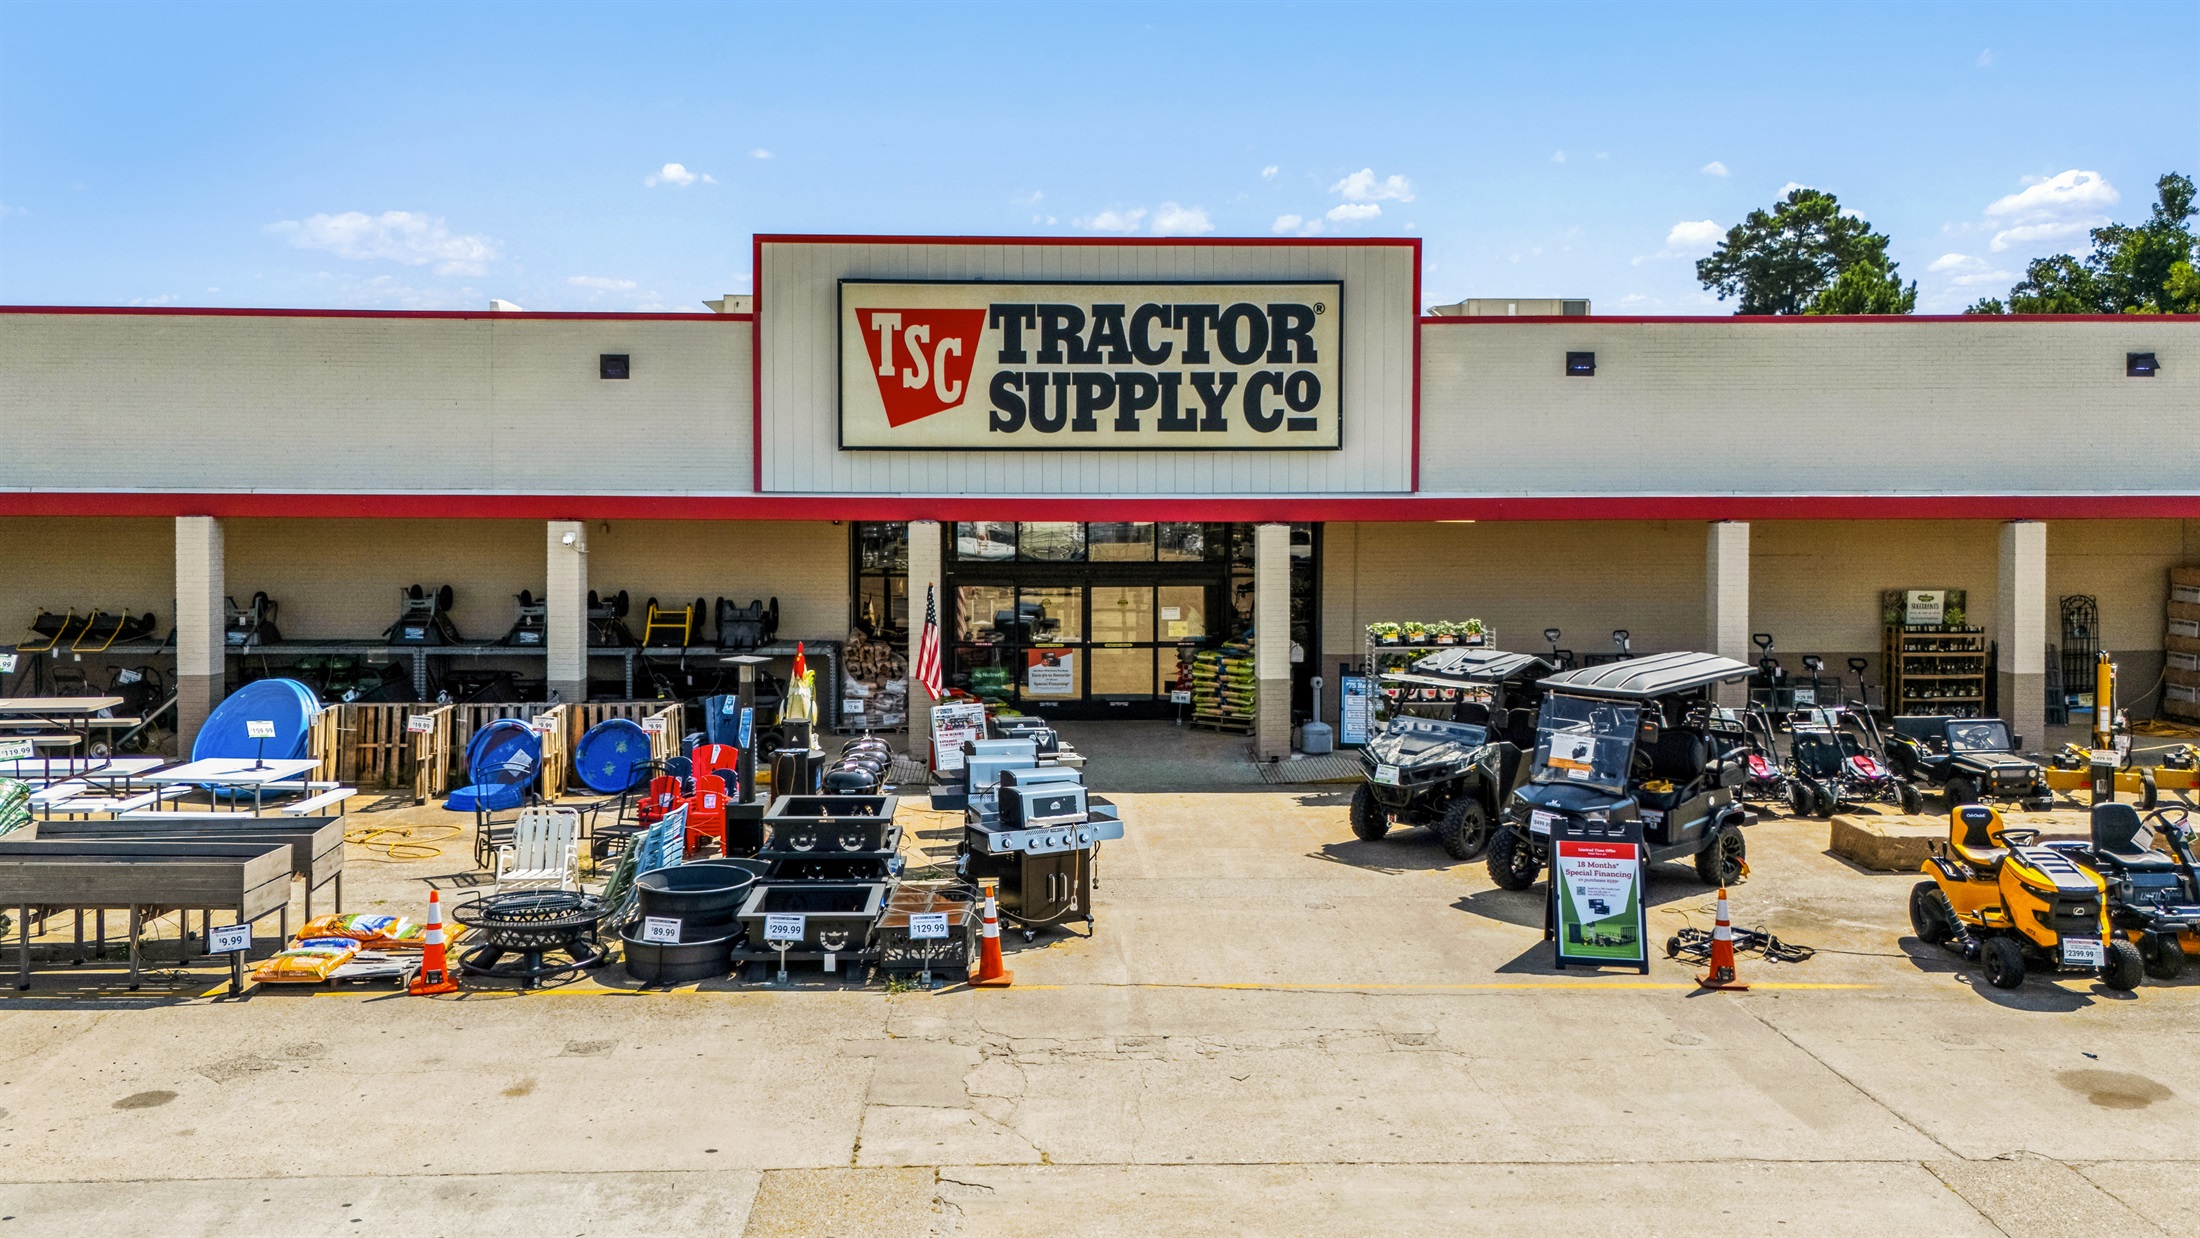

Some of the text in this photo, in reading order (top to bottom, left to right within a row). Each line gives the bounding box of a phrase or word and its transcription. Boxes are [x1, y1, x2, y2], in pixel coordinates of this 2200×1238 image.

[871, 312, 963, 404] TSC
[989, 370, 1238, 433] SUPPLY
[1565, 868, 1632, 879] Special Financing
[651, 927, 676, 937] $89.99
[770, 924, 801, 935] $299.99
[913, 924, 945, 933] $129.99
[219, 935, 243, 946] $9.99
[2066, 949, 2094, 958] $2399.99
